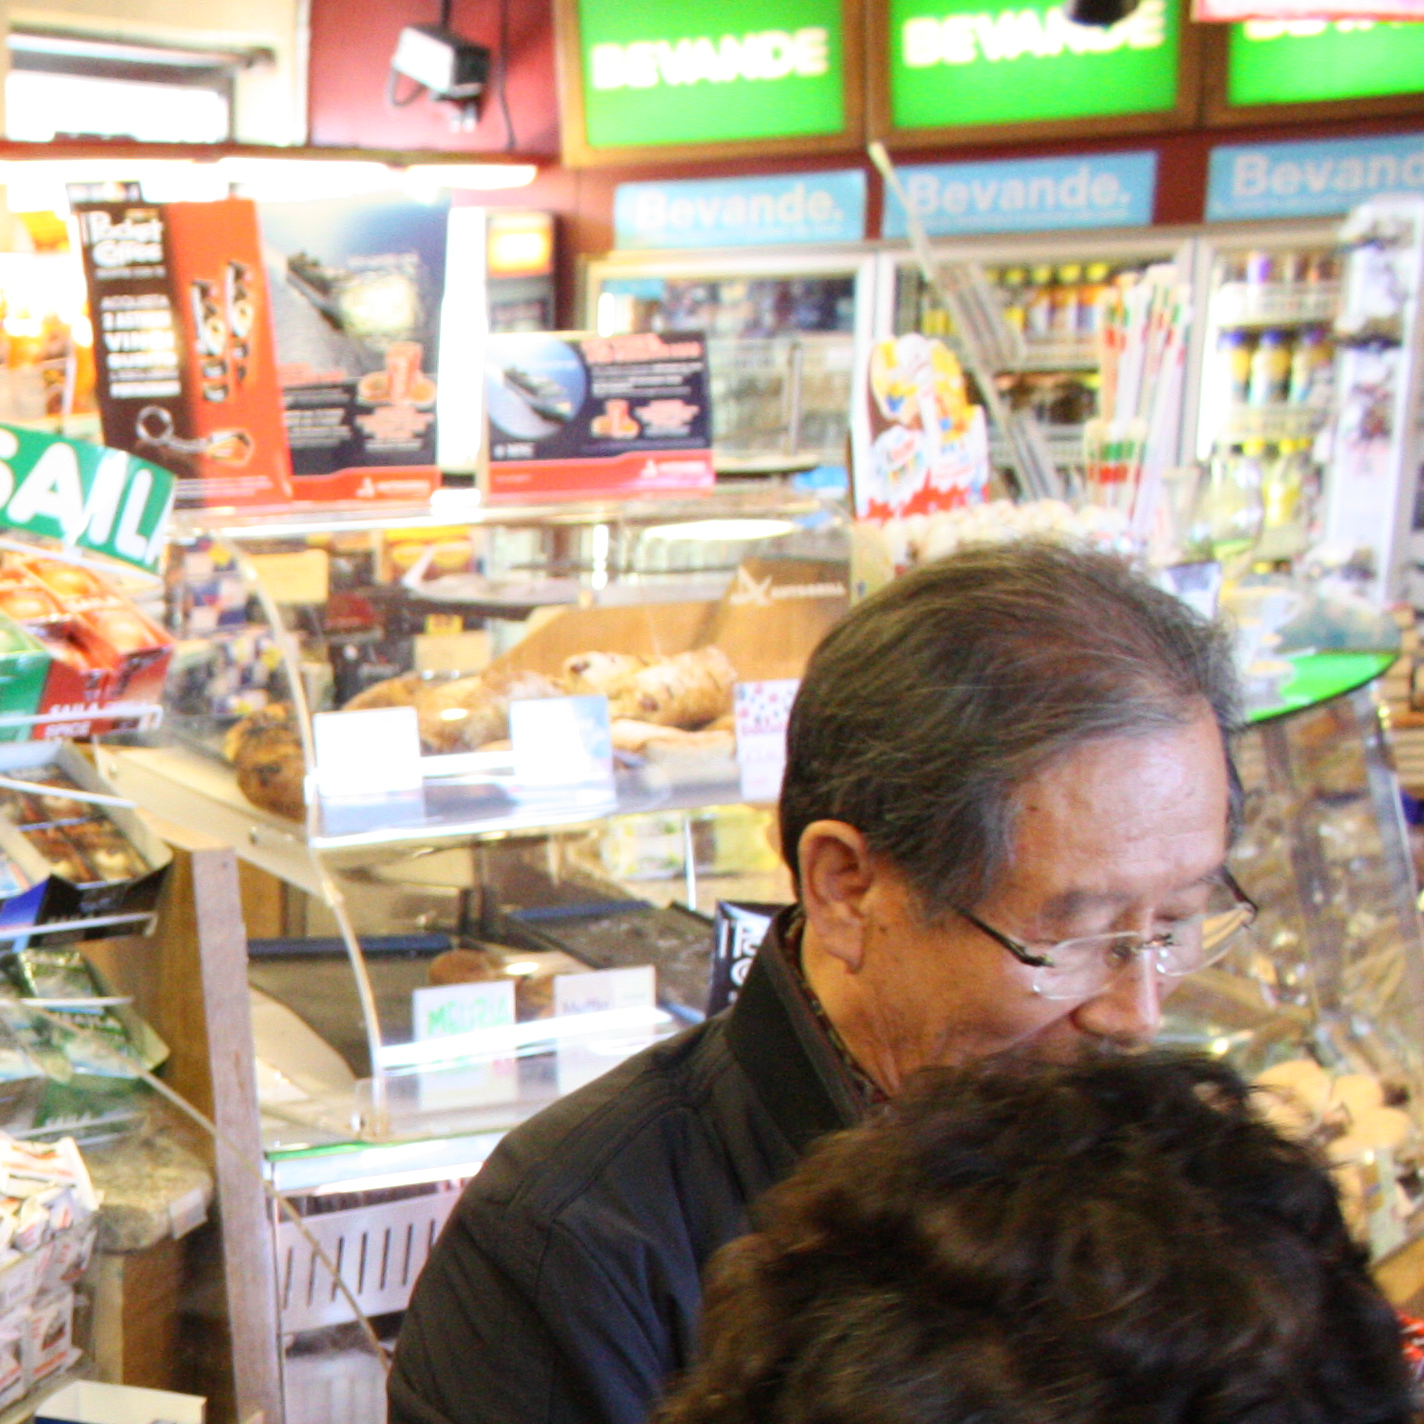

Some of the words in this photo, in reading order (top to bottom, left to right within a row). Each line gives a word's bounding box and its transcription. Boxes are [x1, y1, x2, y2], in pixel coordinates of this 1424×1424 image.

[590, 27, 829, 91] BEVANDE
[634, 180, 845, 233] Bevande.
[905, 165, 1131, 216] Bevande.
